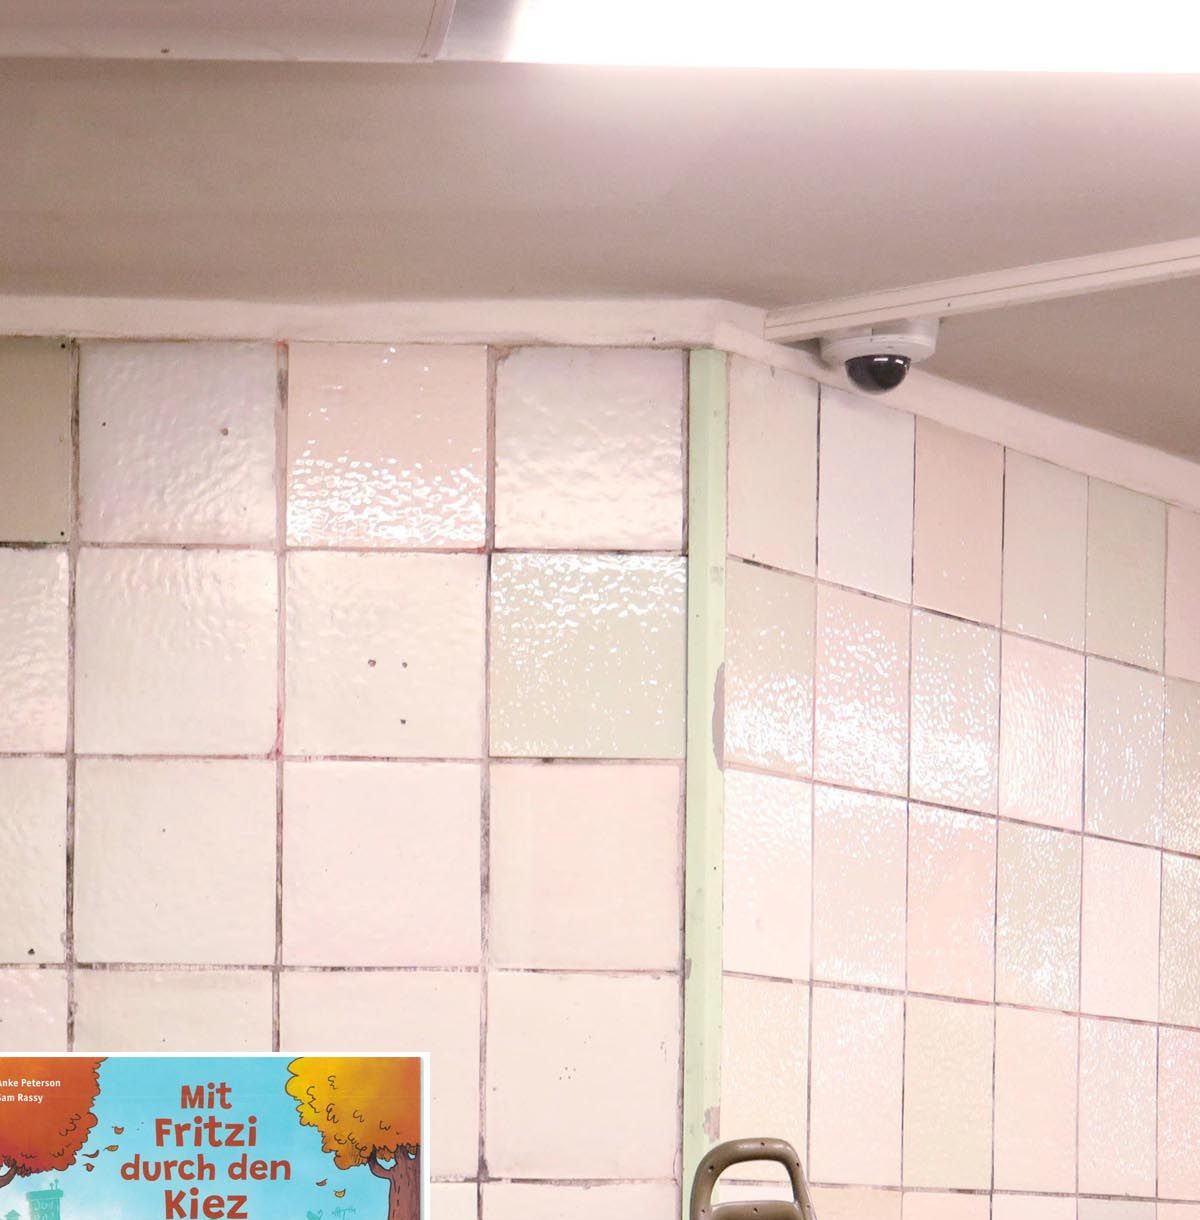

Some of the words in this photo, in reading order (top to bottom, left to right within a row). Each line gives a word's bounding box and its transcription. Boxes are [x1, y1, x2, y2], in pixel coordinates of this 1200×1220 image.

[21, 1077, 61, 1088] Peterson
[180, 1082, 232, 1110] Mit
[17, 1093, 43, 1105] Rassy
[155, 1115, 257, 1148] Fritzi
[120, 1153, 216, 1181] durch
[227, 1153, 292, 1181] den
[164, 1187, 249, 1220] Kiez
